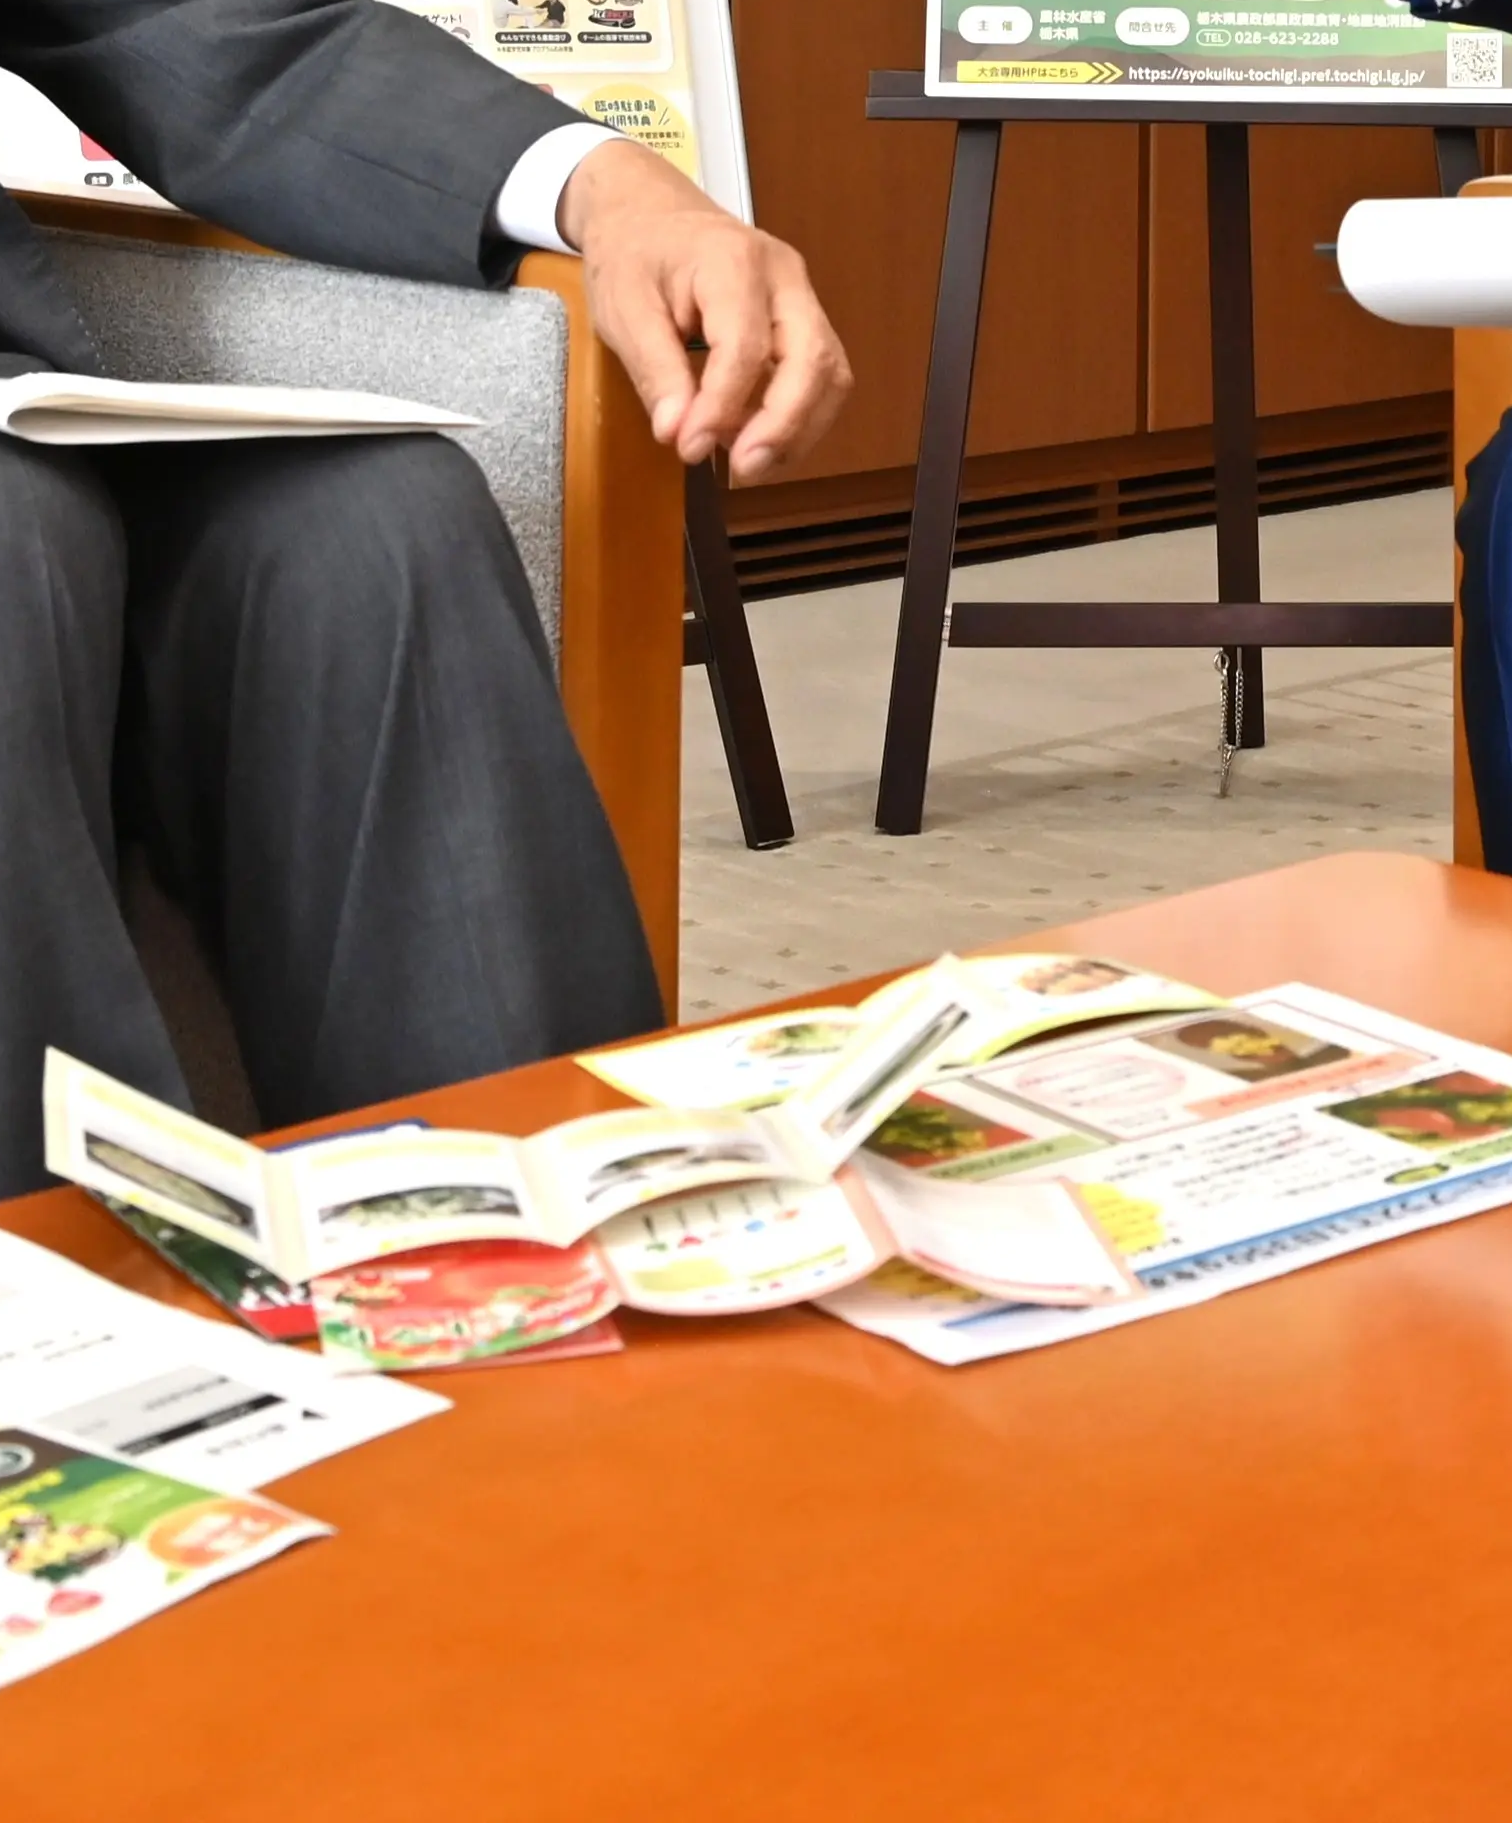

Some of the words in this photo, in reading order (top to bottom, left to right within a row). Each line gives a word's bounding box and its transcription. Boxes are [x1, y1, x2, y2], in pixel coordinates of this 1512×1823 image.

[1039, 9, 1107, 25] 農林水産省
[1038, 27, 1079, 41] 栃木県
[1128, 22, 1177, 34] 問合せ先
[1204, 32, 1224, 43] TEL
[1234, 31, 1339, 46] 028-623-2288
[977, 66, 1079, 78] 大会専用HPはこちら
[1128, 66, 1426, 86] https://syokuiku-tochigi.pref.tochigi.lg.jp/
[594, 99, 657, 113] 臨時駐車場
